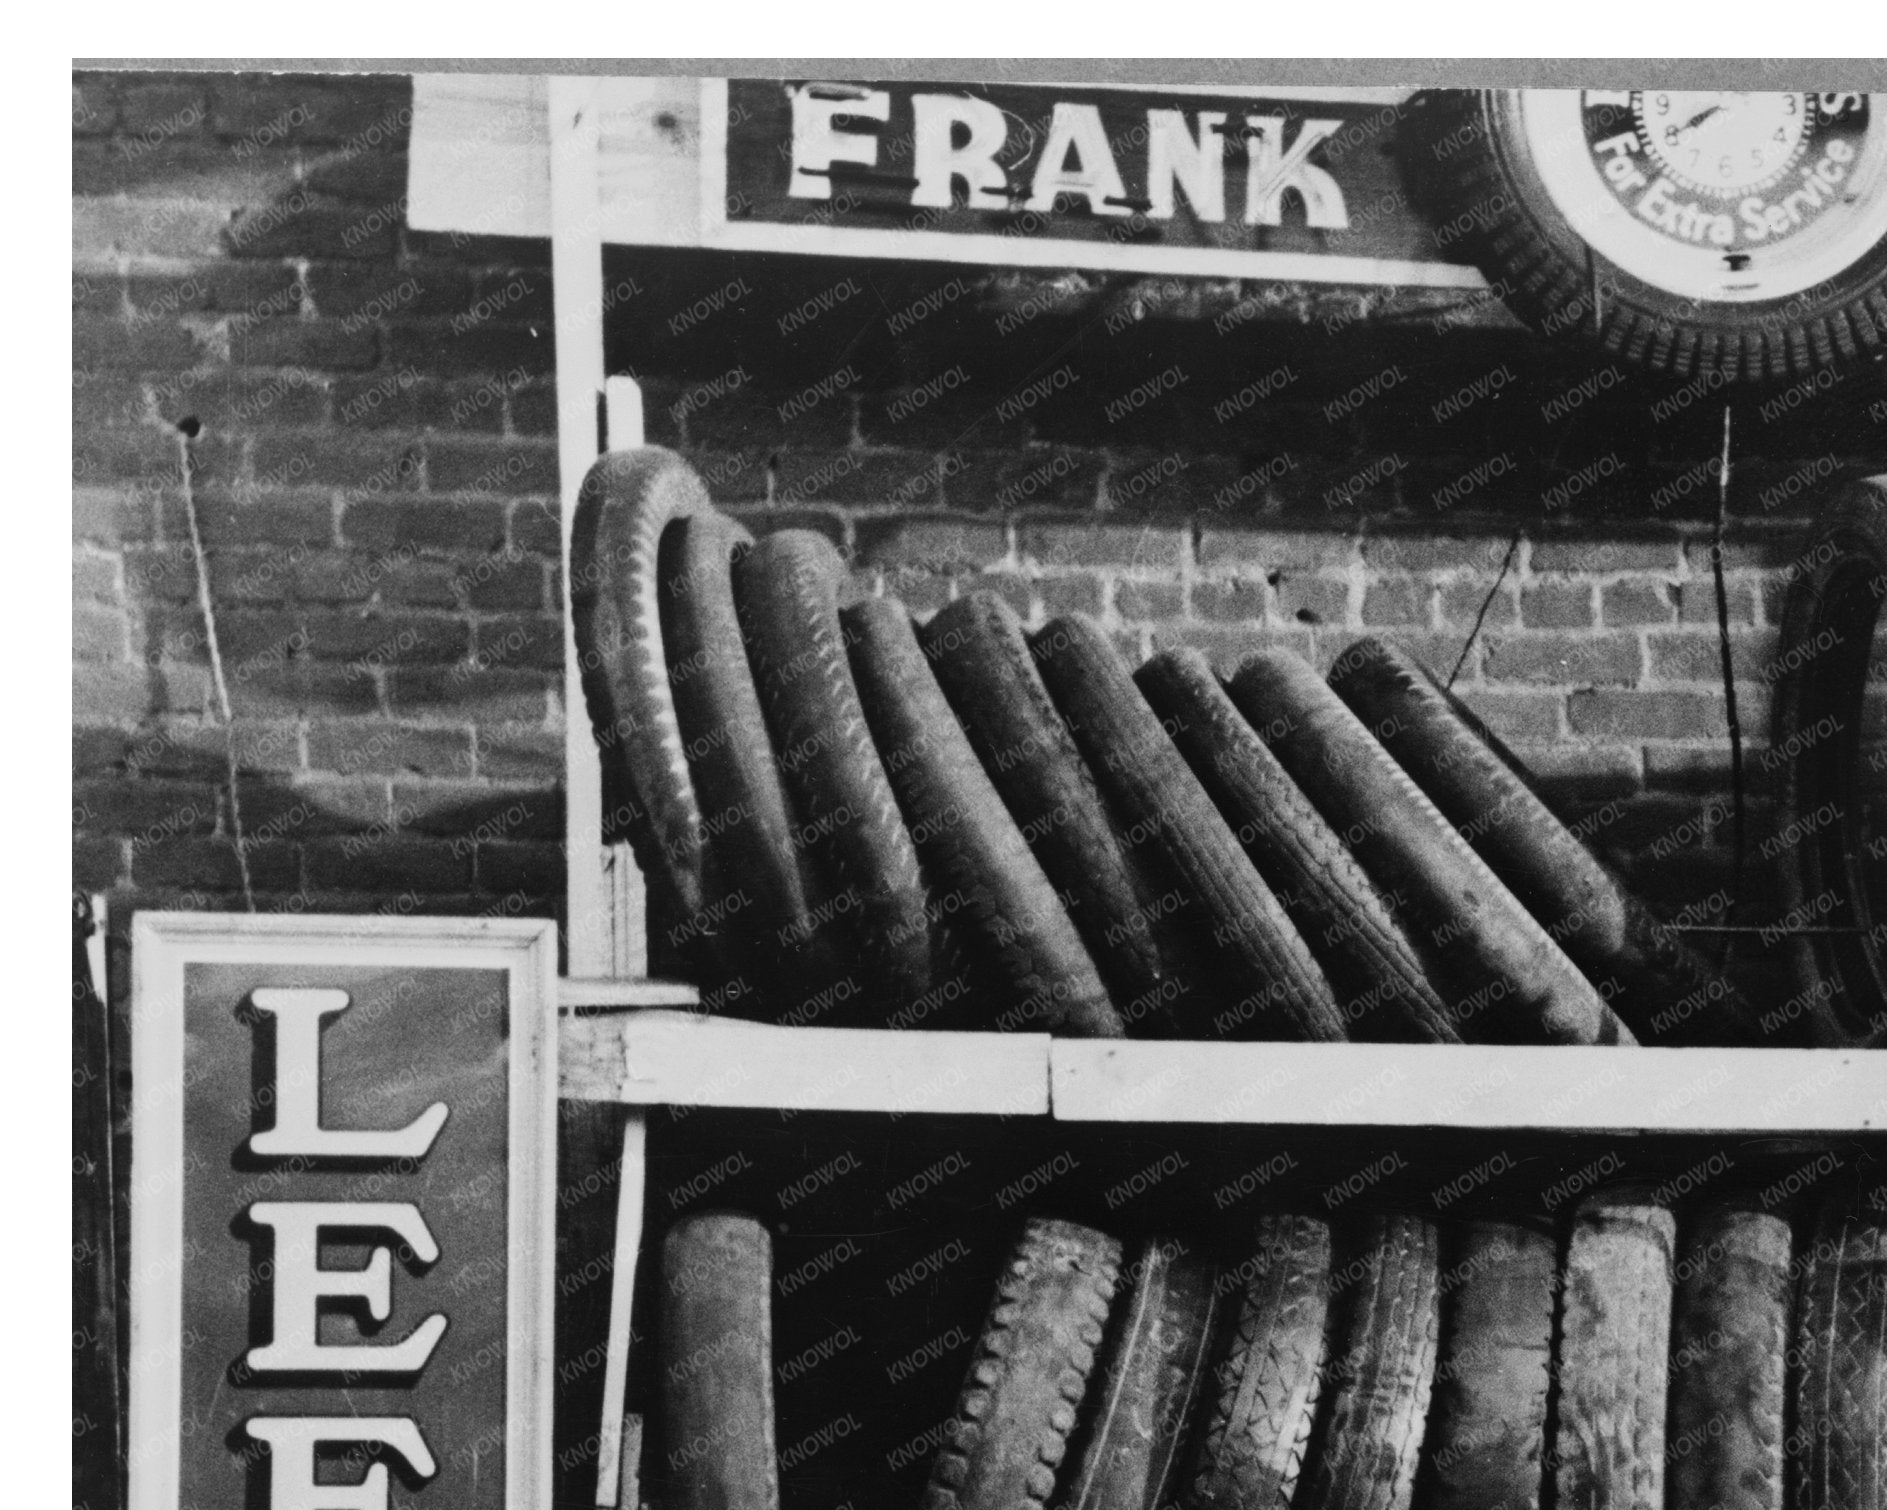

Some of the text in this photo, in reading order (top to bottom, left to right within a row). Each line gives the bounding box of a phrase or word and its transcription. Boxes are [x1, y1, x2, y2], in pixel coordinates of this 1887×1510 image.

[786, 83, 1348, 229] FRANK
[1594, 131, 1854, 246] For Extra Service
